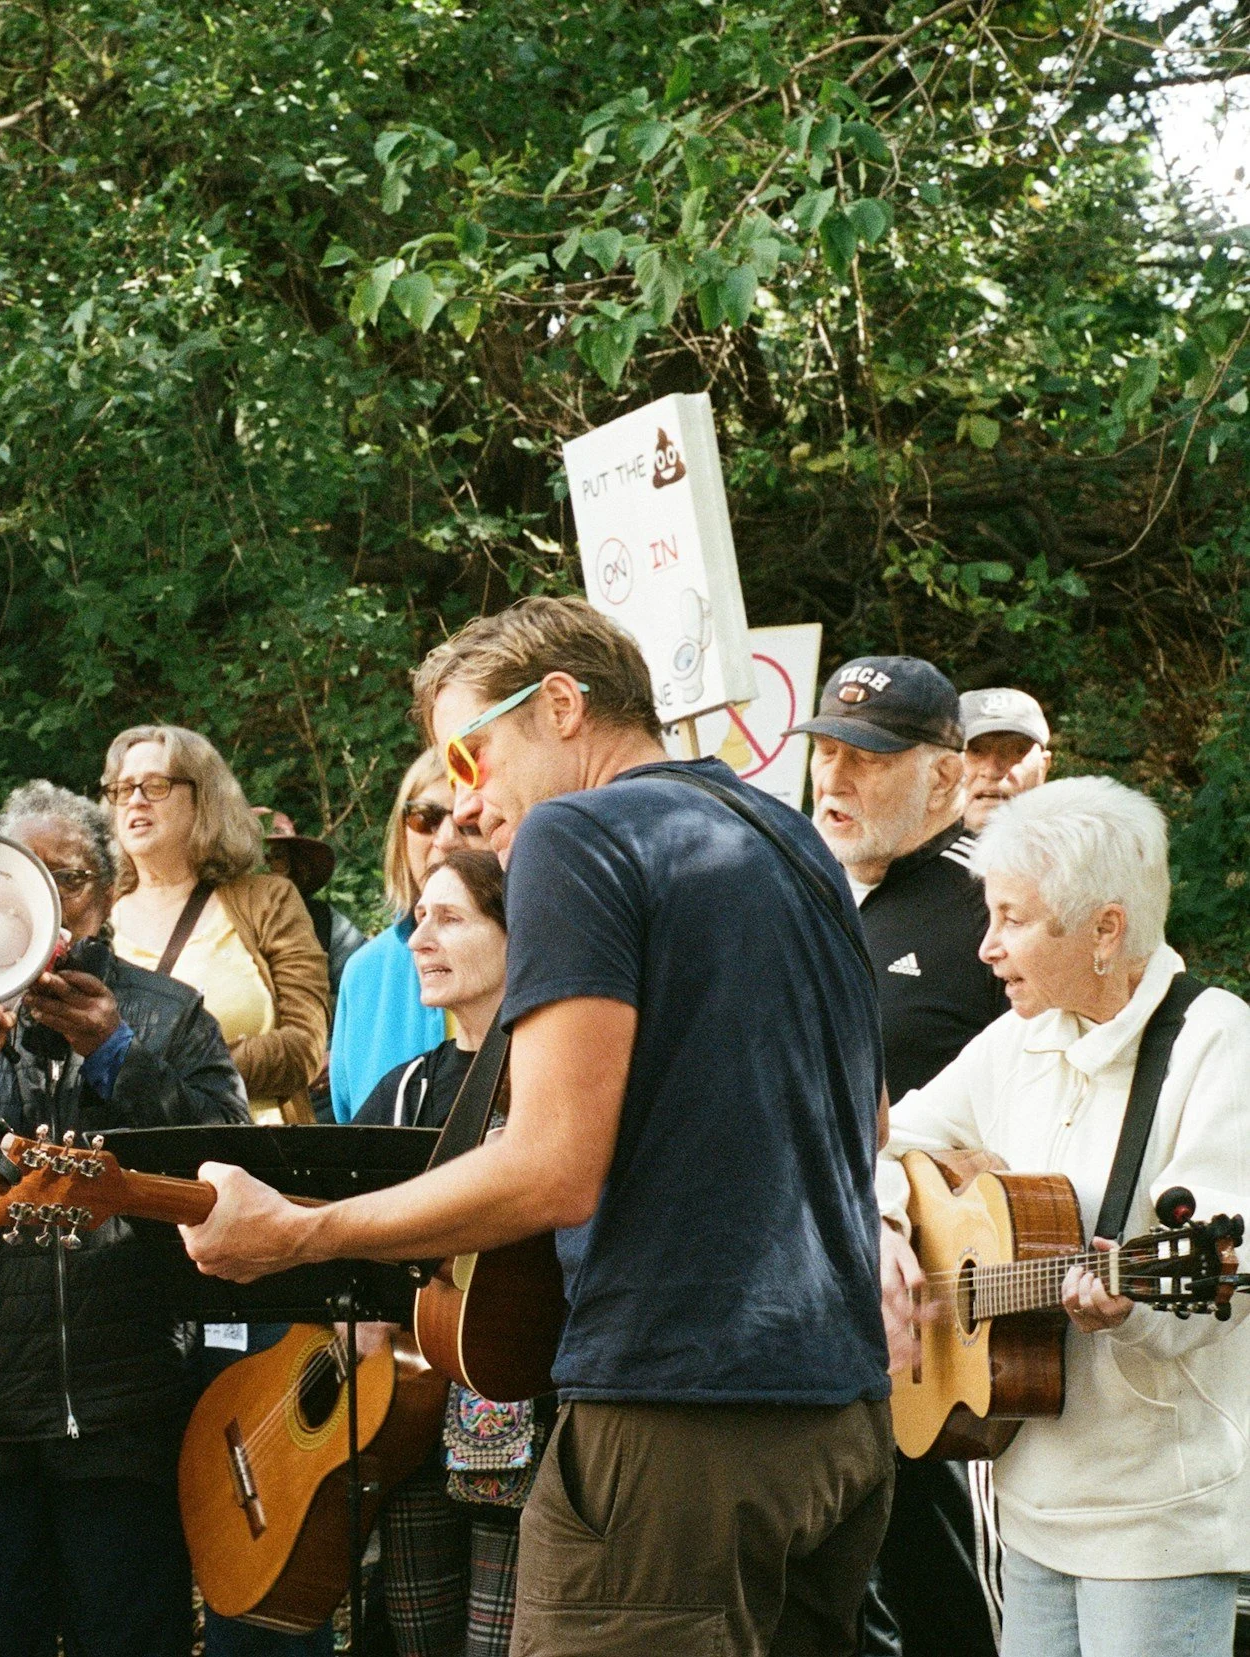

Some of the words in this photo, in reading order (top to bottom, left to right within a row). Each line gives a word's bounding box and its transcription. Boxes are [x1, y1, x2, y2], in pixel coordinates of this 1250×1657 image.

[582, 472, 608, 501] PUT
[615, 454, 646, 484] THE
[649, 534, 678, 569] IN
